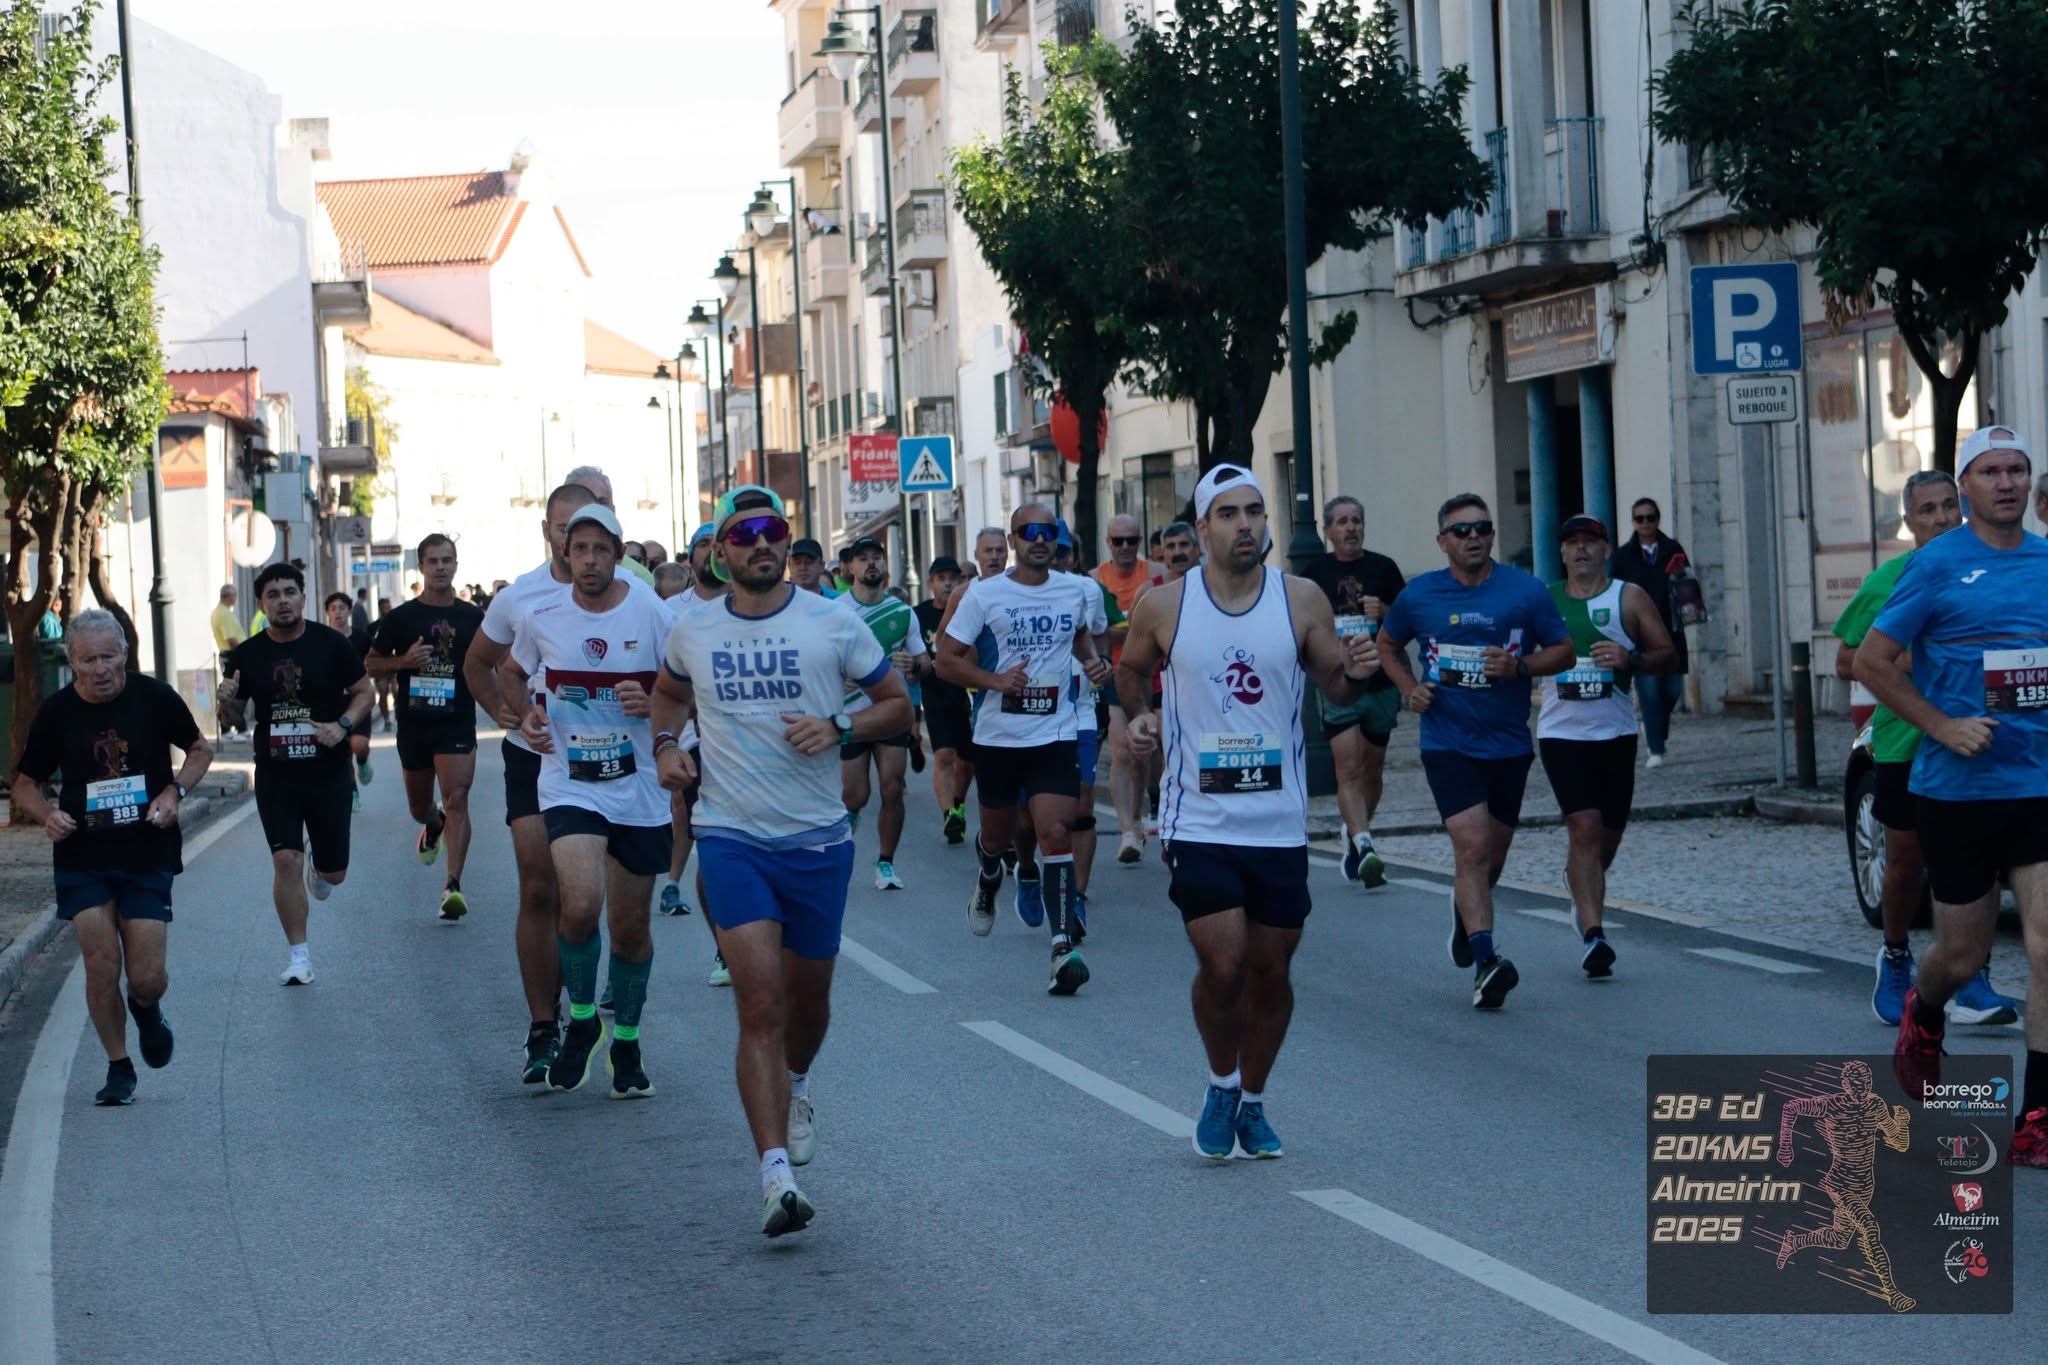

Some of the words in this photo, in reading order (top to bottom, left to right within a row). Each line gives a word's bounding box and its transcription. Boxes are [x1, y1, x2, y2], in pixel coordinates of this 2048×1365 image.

[1713, 278, 1777, 361] P
[1764, 359, 1789, 368] LUGAR
[1736, 387, 1776, 399] SUJEITO
[1781, 385, 1788, 396] A
[1738, 402, 1787, 414] REBOQUE
[1029, 614, 1073, 633] 10/5
[724, 637, 786, 648] ULTRA
[1007, 635, 1053, 647] MILLES
[712, 650, 800, 679] BLUE
[1450, 660, 1485, 672] 20KM
[1462, 672, 1487, 684] 276
[1567, 672, 1601, 682] 20KM
[2004, 668, 2048, 685] 10KM
[419, 688, 446, 697] 20KM
[715, 680, 802, 701] ISLAND
[1023, 688, 1048, 697] 0KM
[1579, 683, 1602, 693] 149
[1022, 698, 1052, 709] 1309
[272, 708, 311, 720] 20KMS
[281, 736, 311, 745] 10KM
[581, 734, 610, 745] borrego
[1218, 736, 1255, 748] borrego
[288, 745, 317, 755] 1200
[581, 748, 621, 761] 20KM
[1217, 753, 1265, 767] 20KM
[601, 760, 620, 773] 23
[1241, 767, 1263, 782] 14
[97, 793, 135, 809] 20KM
[113, 805, 139, 820] 383
